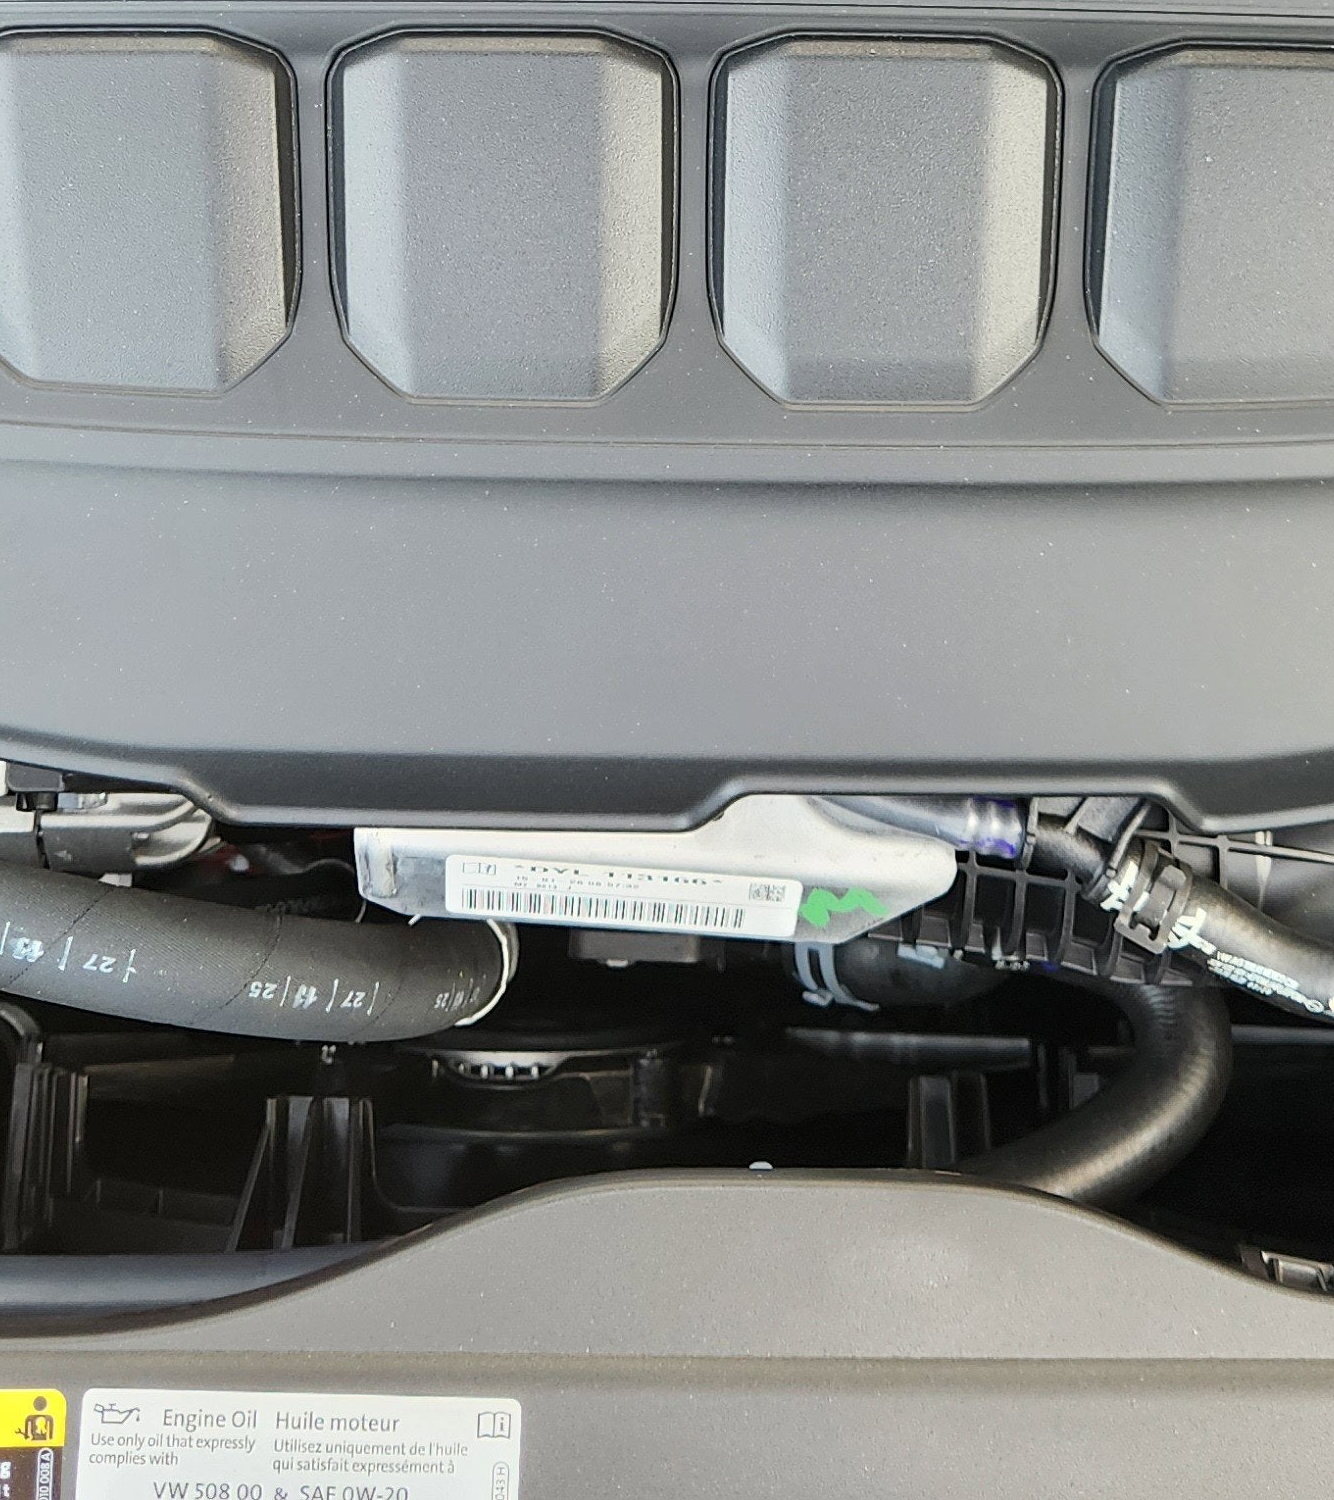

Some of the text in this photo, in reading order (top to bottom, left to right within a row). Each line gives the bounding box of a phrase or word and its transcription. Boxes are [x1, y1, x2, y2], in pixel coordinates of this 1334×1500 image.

[82, 953, 117, 974] 27
[248, 979, 280, 1000] 25
[341, 992, 365, 1013] 27
[163, 1408, 257, 1432] Engine Oil
[276, 1411, 400, 1432] Huile moteur
[91, 1432, 256, 1454] Use only oil that expressly
[274, 1438, 468, 1459] Utilisez uniquement de l'huile
[89, 1452, 179, 1468] complies with
[272, 1457, 456, 1477] qui satisfait expressément à
[2, 1485, 10, 1499] t
[153, 1481, 190, 1500] VW
[195, 1482, 230, 1500] 508
[237, 1483, 263, 1500] 00
